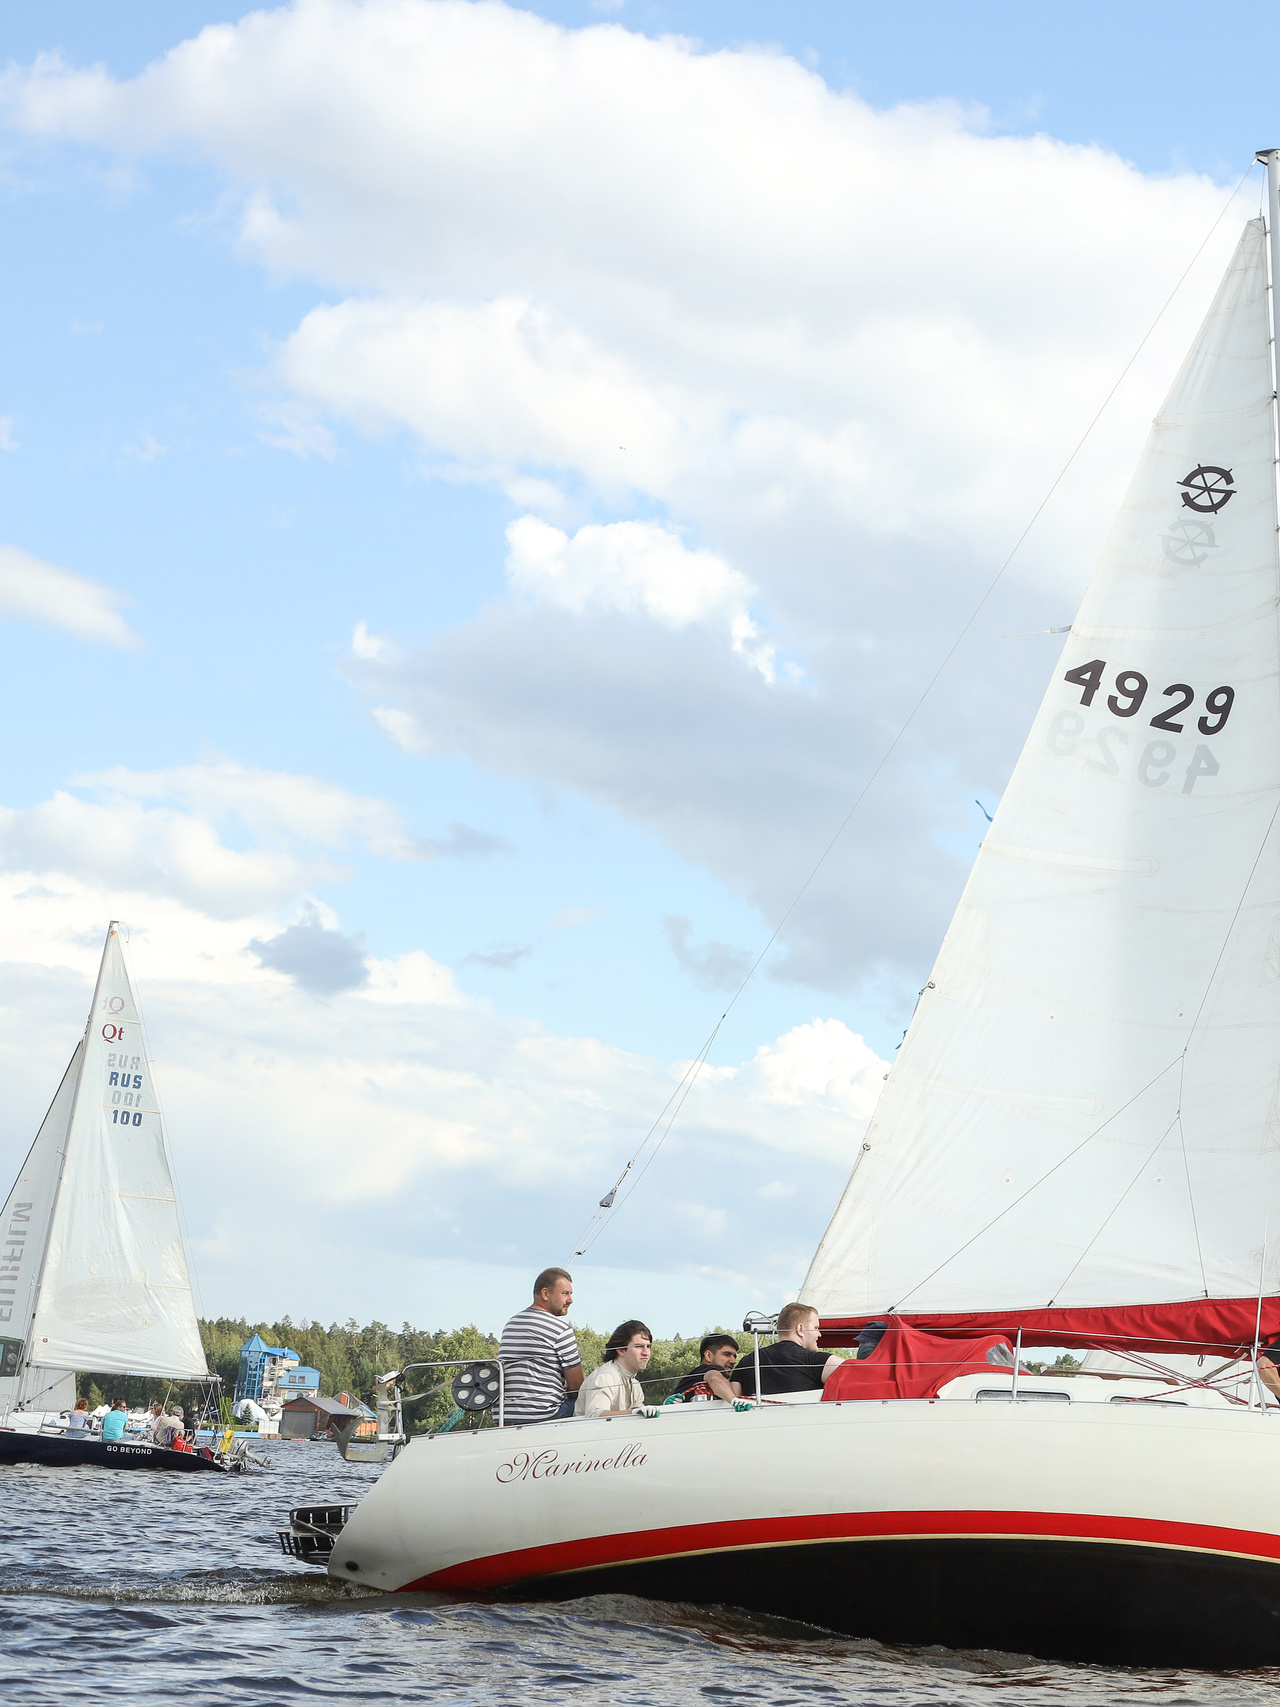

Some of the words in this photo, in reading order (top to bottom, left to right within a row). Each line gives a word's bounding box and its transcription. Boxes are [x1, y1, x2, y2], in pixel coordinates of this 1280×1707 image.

[1063, 659, 1235, 736] 4929
[101, 1023, 125, 1044] Qt
[108, 1071, 143, 1090] RUS
[112, 1109, 143, 1127] 100
[120, 1447, 152, 1455] BEYOND
[495, 1442, 650, 1484] Marinella
